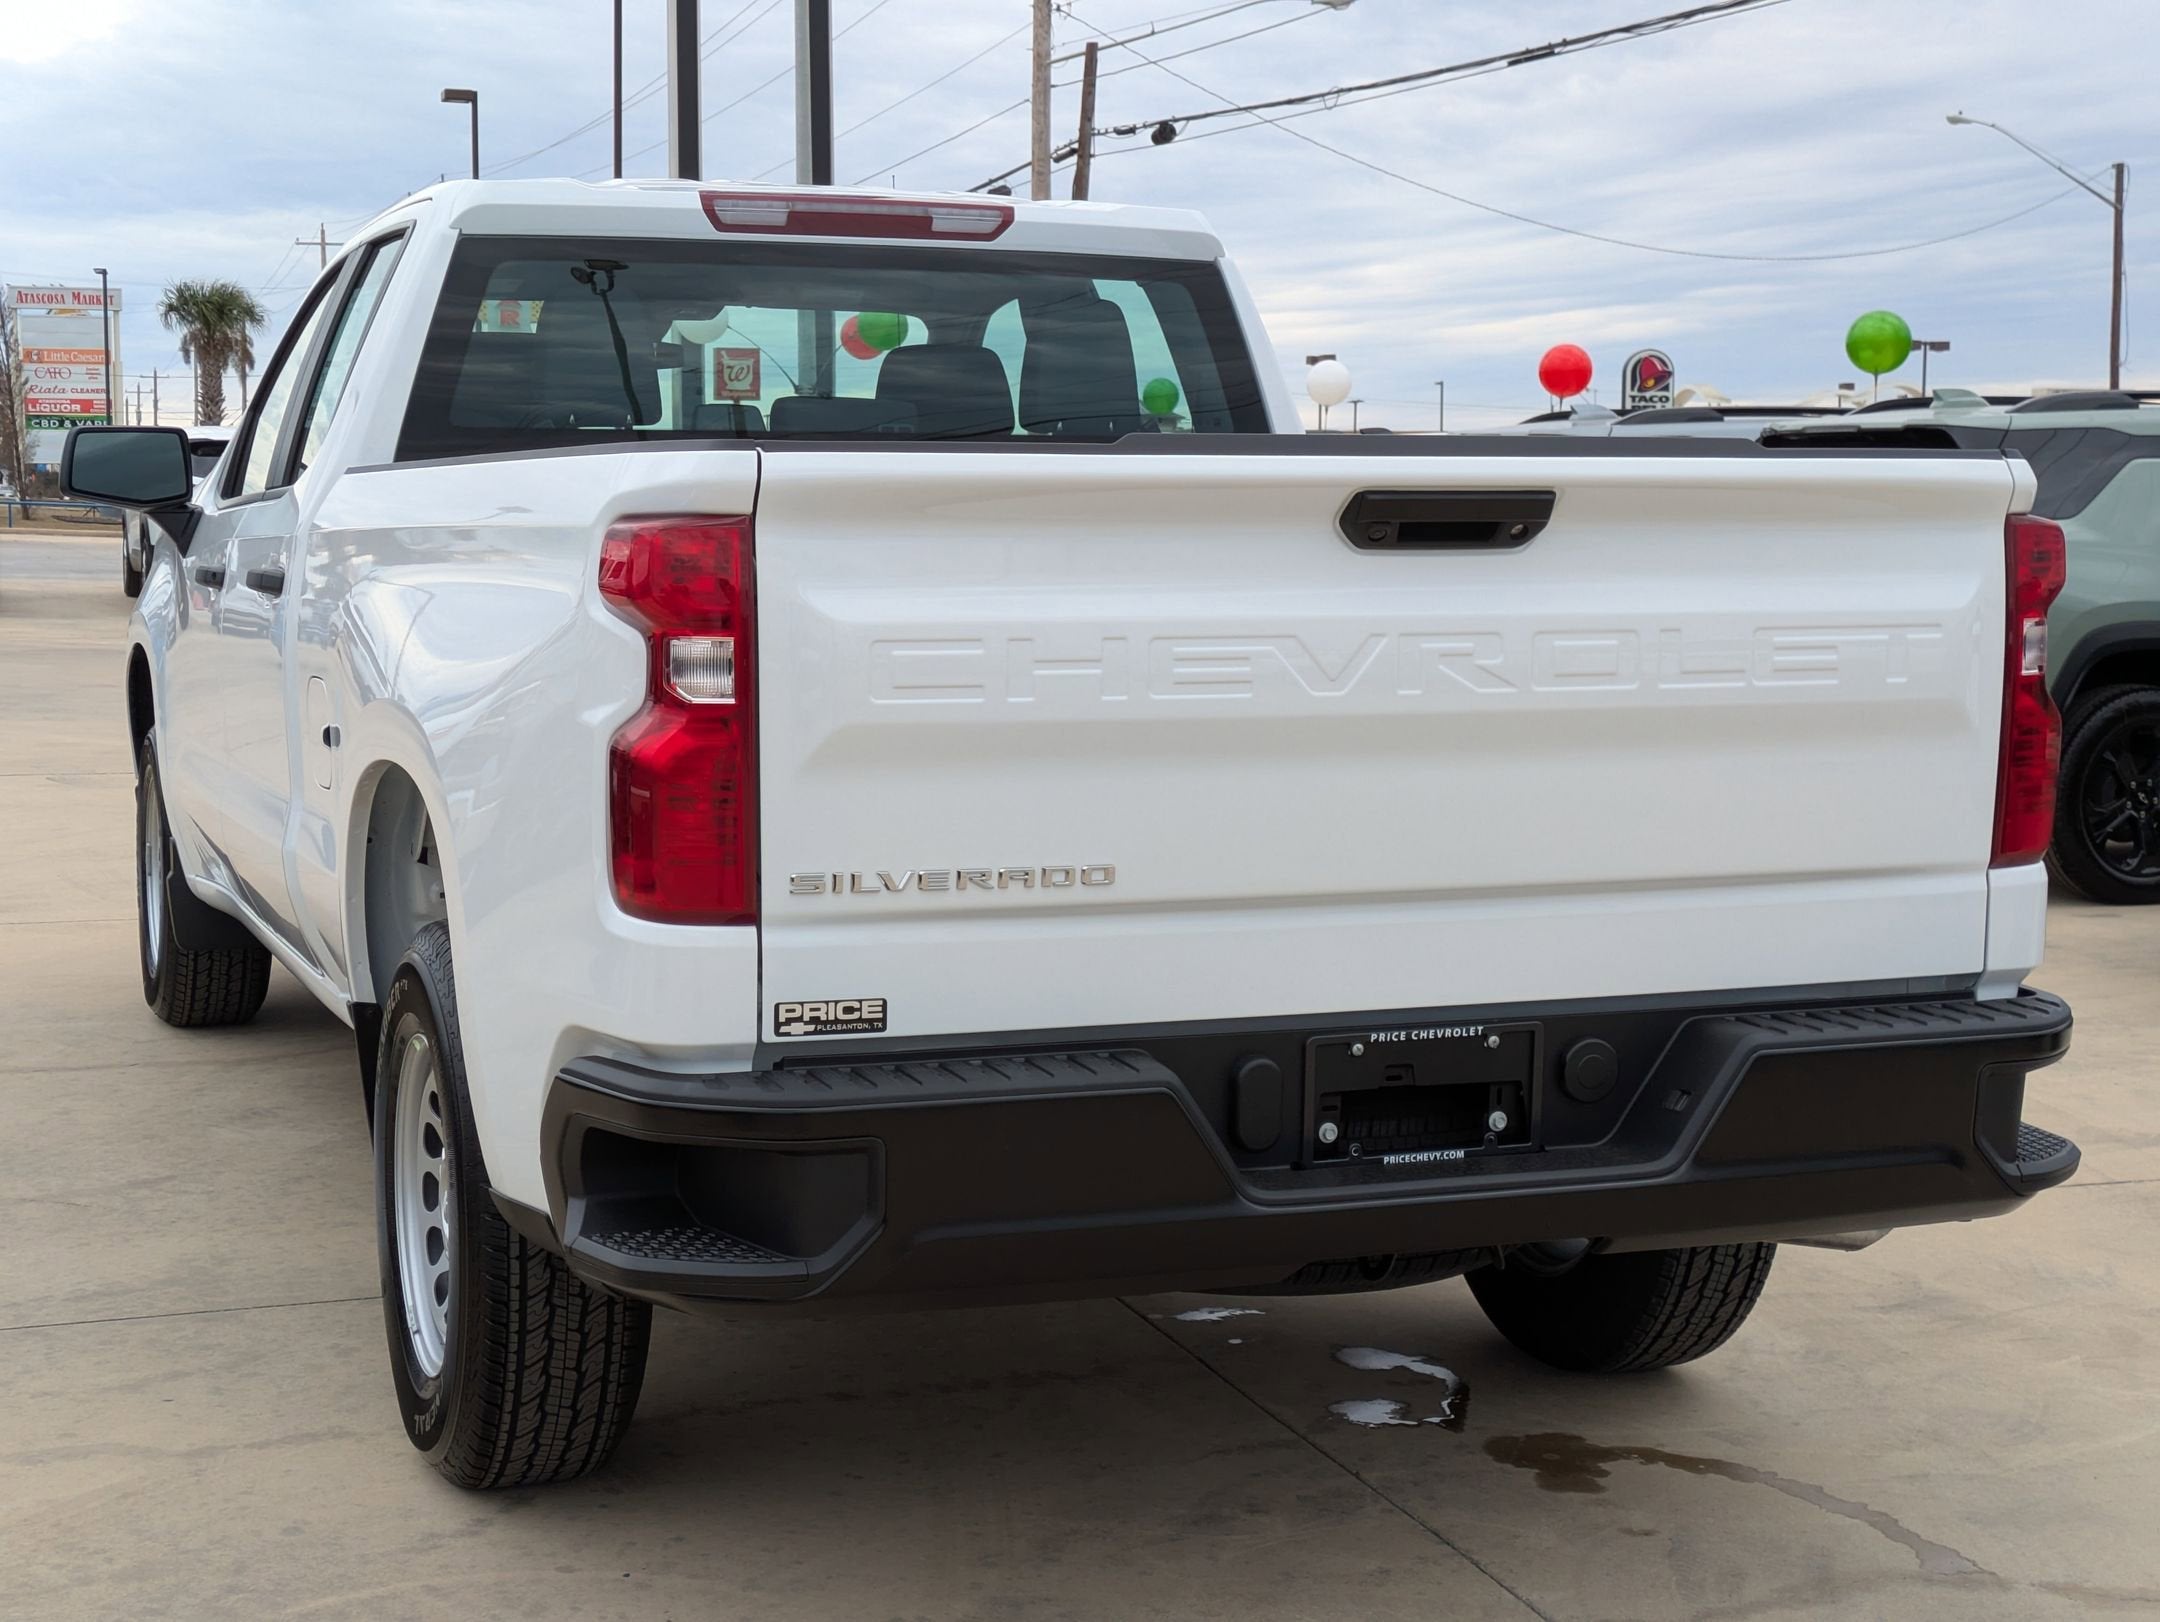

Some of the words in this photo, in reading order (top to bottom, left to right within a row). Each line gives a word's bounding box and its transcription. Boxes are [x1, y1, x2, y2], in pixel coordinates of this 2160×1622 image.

[16, 290, 66, 305] ATASCOSA
[71, 291, 115, 306] MARKT
[44, 351, 70, 362] Little
[70, 351, 105, 363] Caesar
[34, 366, 72, 380] CATO
[26, 384, 69, 394] Riata
[1629, 395, 1670, 404] TACO
[27, 403, 81, 412] LIQUOR
[31, 419, 60, 428] CBD
[63, 420, 72, 428] &
[867, 622, 1945, 704] CHEVROLET
[789, 863, 1116, 895] SILVERADO
[779, 1000, 884, 1022] PRICE
[816, 1022, 871, 1031] PLEASANTON,
[1370, 1032, 1406, 1042] PRICE
[1411, 1026, 1484, 1040] CHEVROLET
[1383, 1150, 1465, 1165] PRICECHEVY.COM
